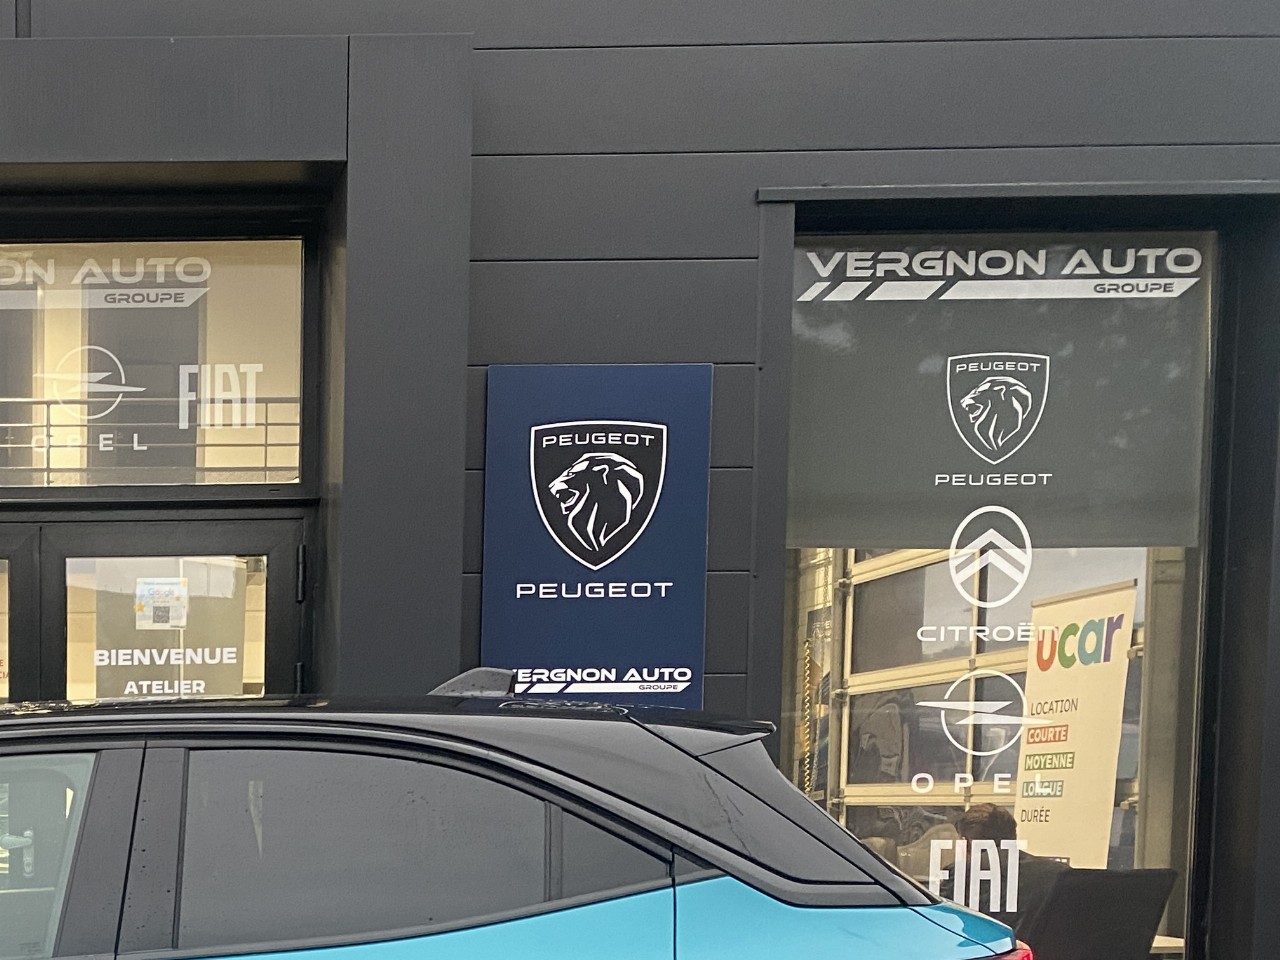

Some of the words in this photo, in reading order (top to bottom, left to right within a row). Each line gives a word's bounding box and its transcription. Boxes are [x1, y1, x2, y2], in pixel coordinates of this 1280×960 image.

[71, 256, 212, 285] AUTO
[806, 249, 1046, 278] VERGNON
[1061, 247, 1202, 275] AUTO
[1093, 282, 1175, 294] GROUPE
[104, 292, 185, 304] GROUPE
[956, 361, 1041, 373] PEUGEOT
[178, 363, 263, 430] FIAT
[31, 432, 148, 452] OPEL
[542, 433, 655, 448] PEUGEOT
[935, 473, 1053, 486] PEUGEOT
[516, 582, 674, 599] PEUGEOT
[917, 622, 1057, 642] CITROËN
[1036, 613, 1125, 672] ucar
[93, 647, 237, 667] BIENVENUE
[513, 668, 617, 682] ERGNON
[622, 667, 692, 682] AUTO
[123, 679, 206, 695] ATELIER
[1030, 698, 1079, 716] LOCATION
[1027, 727, 1067, 743] COURTE
[1025, 754, 1074, 770] MOYENNE
[910, 772, 1052, 794] OPEL
[1020, 808, 1050, 824] DURÉE
[929, 839, 1028, 912] FIAT
